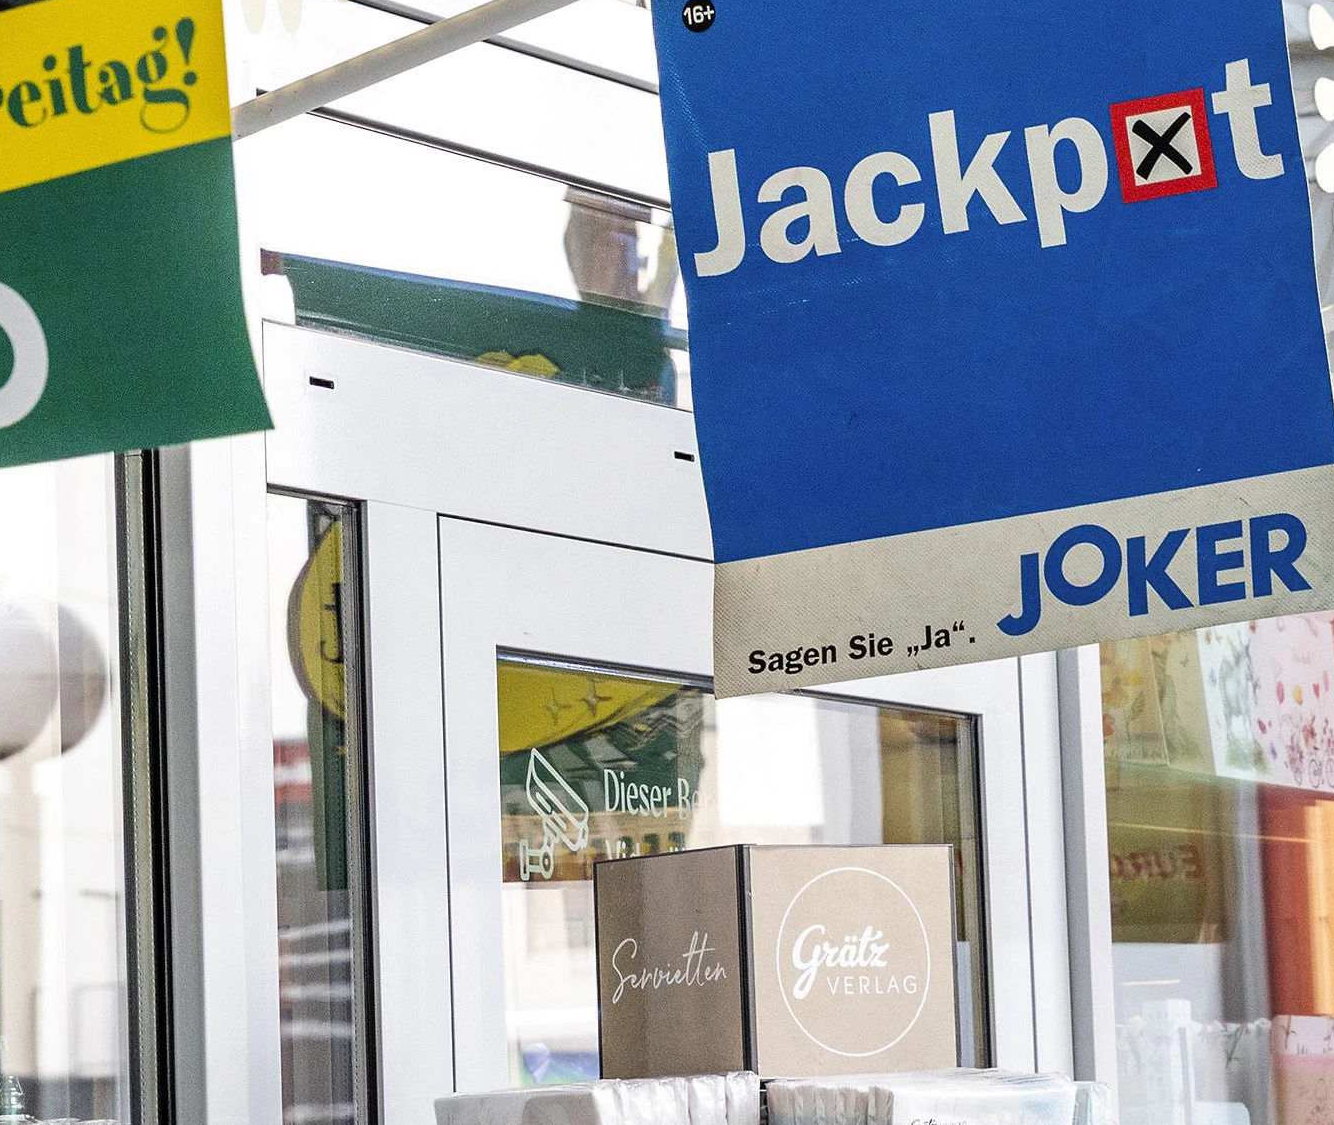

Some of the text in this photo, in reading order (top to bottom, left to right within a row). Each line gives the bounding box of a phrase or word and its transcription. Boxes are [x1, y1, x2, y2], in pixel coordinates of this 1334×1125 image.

[682, 5, 716, 26] 16+
[997, 512, 1313, 637] JOKER
[747, 641, 837, 675] Sagen
[849, 634, 894, 660] Sie
[603, 768, 672, 818] Dieser
[611, 930, 728, 1005] Servietten
[791, 923, 891, 1000] Grätz
[825, 974, 918, 995] VERLAG
